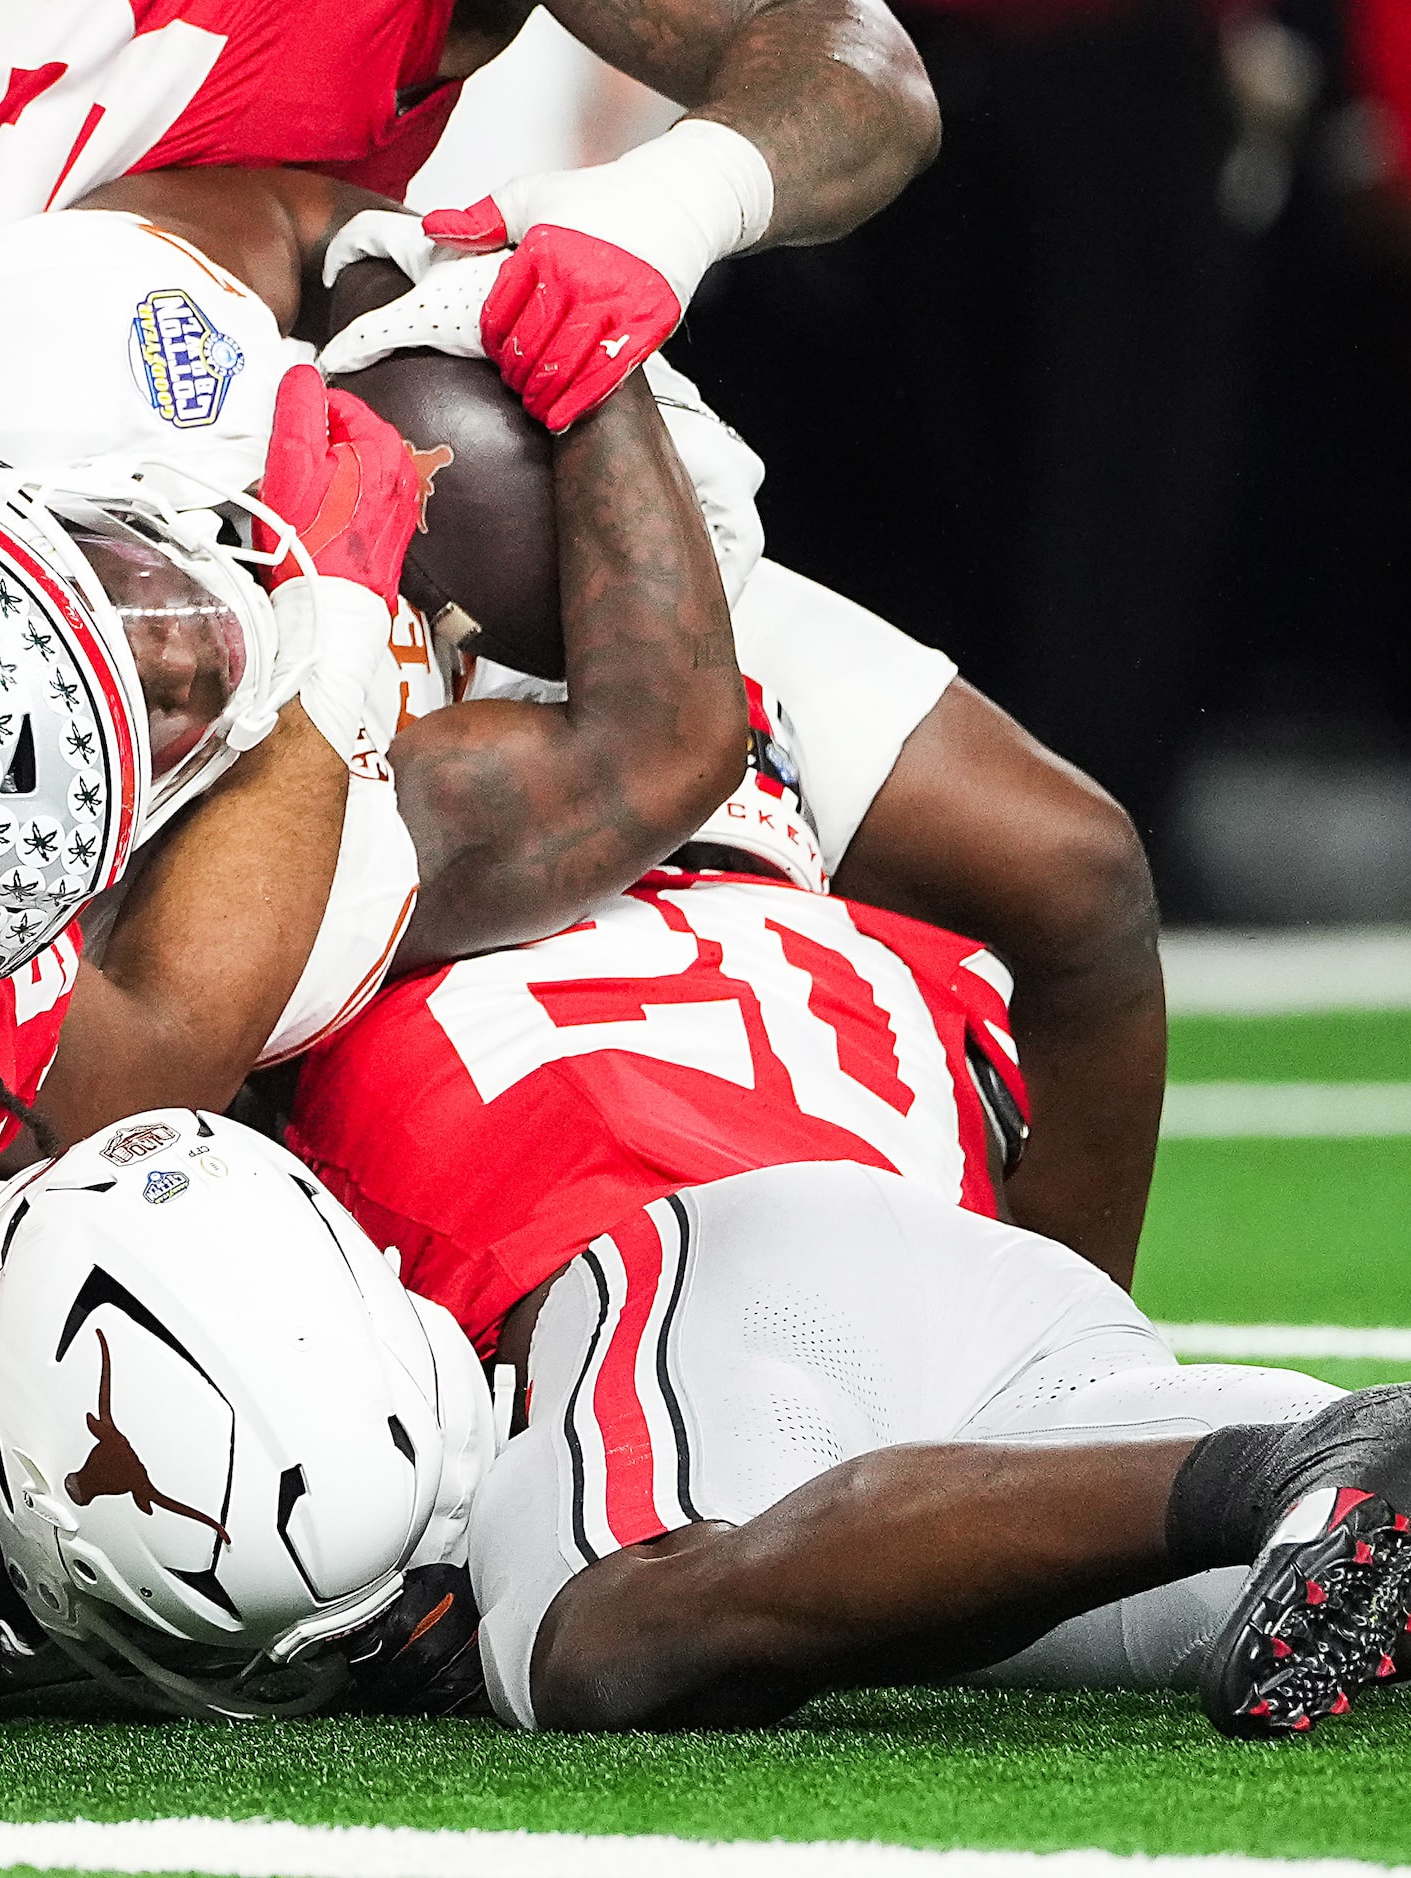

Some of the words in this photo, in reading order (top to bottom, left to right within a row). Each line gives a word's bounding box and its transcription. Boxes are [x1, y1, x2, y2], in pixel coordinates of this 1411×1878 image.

[139, 302, 178, 422] GOODYEAR
[152, 296, 216, 420] COTTON
[183, 316, 216, 396] BOWL
[426, 884, 964, 1206] 20
[188, 1145, 211, 1158] CFP
